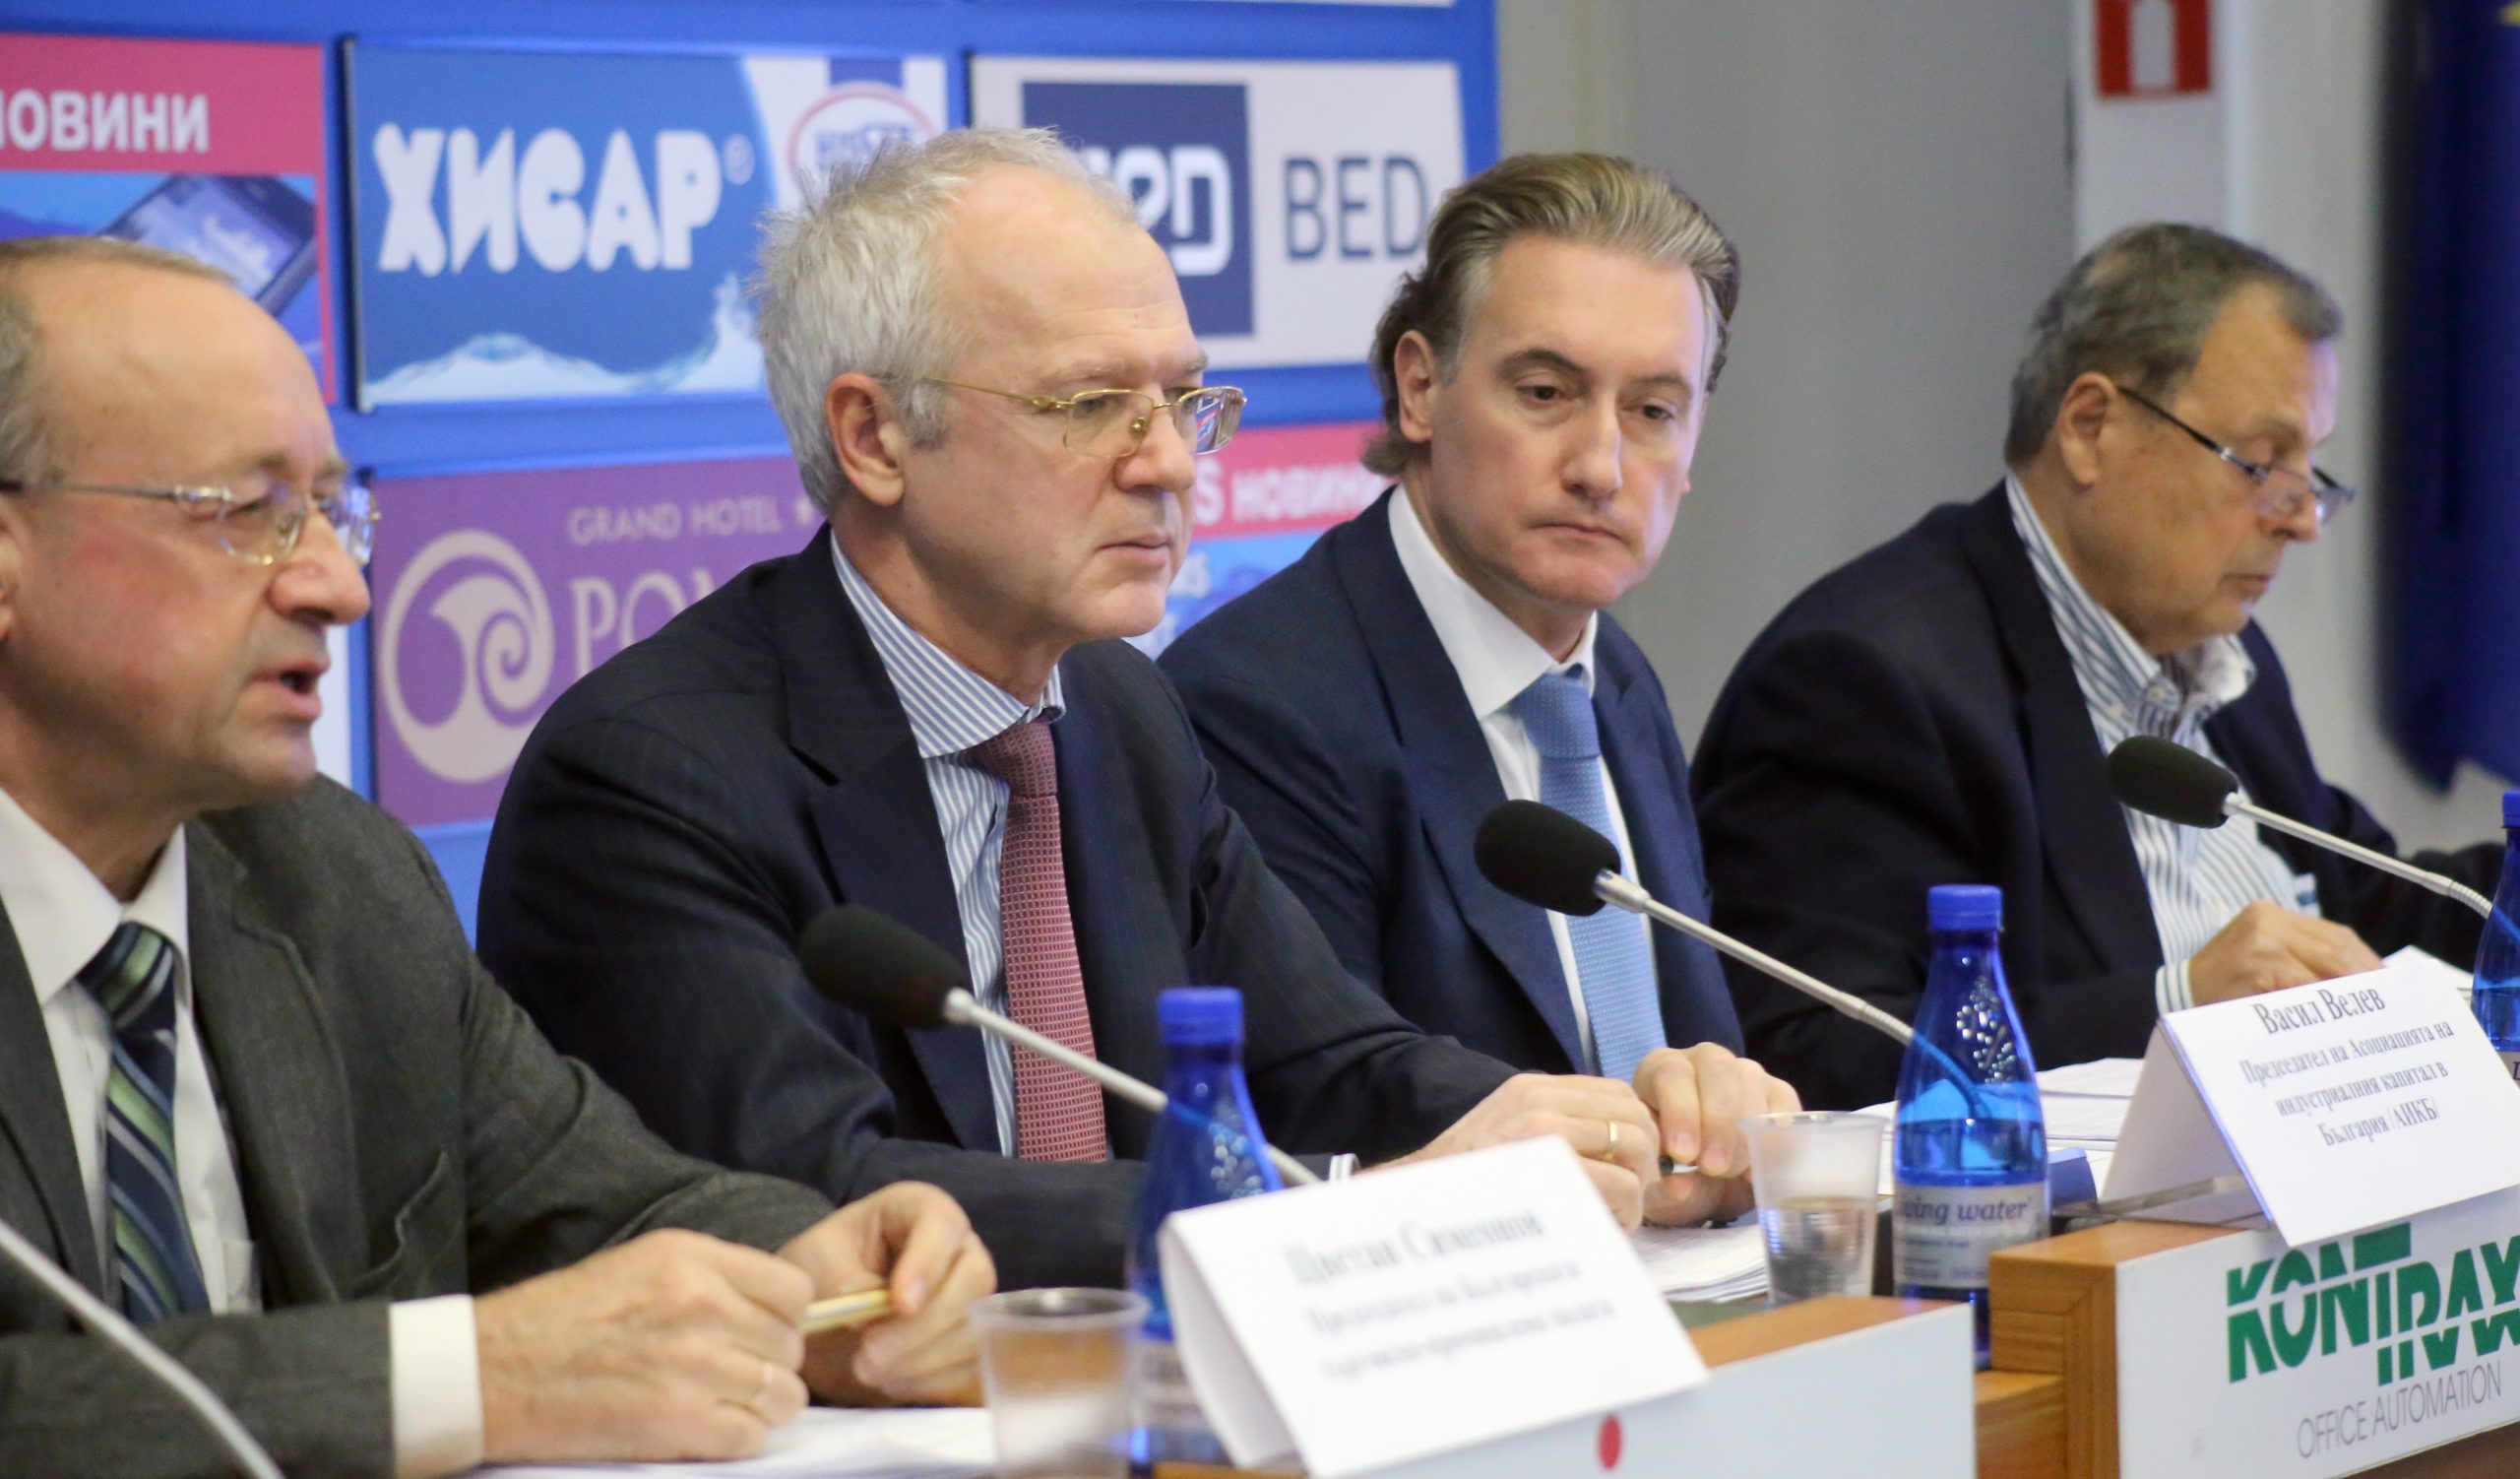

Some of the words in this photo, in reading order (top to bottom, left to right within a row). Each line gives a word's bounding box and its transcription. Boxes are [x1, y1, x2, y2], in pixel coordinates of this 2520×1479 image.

[373, 123, 723, 276] ХИСАР
[1282, 157, 1428, 260] BED
[568, 500, 682, 546] GRAND
[690, 495, 782, 536] HOTEL
[2251, 1000, 2326, 1034] Васил
[2316, 988, 2386, 1020] Велев
[2330, 1044, 2350, 1063] на
[2434, 1021, 2455, 1039] на
[1958, 1199, 2028, 1221] water
[2297, 1400, 2367, 1459] OFFICE
[2371, 1359, 2502, 1437] AUTOMATION
